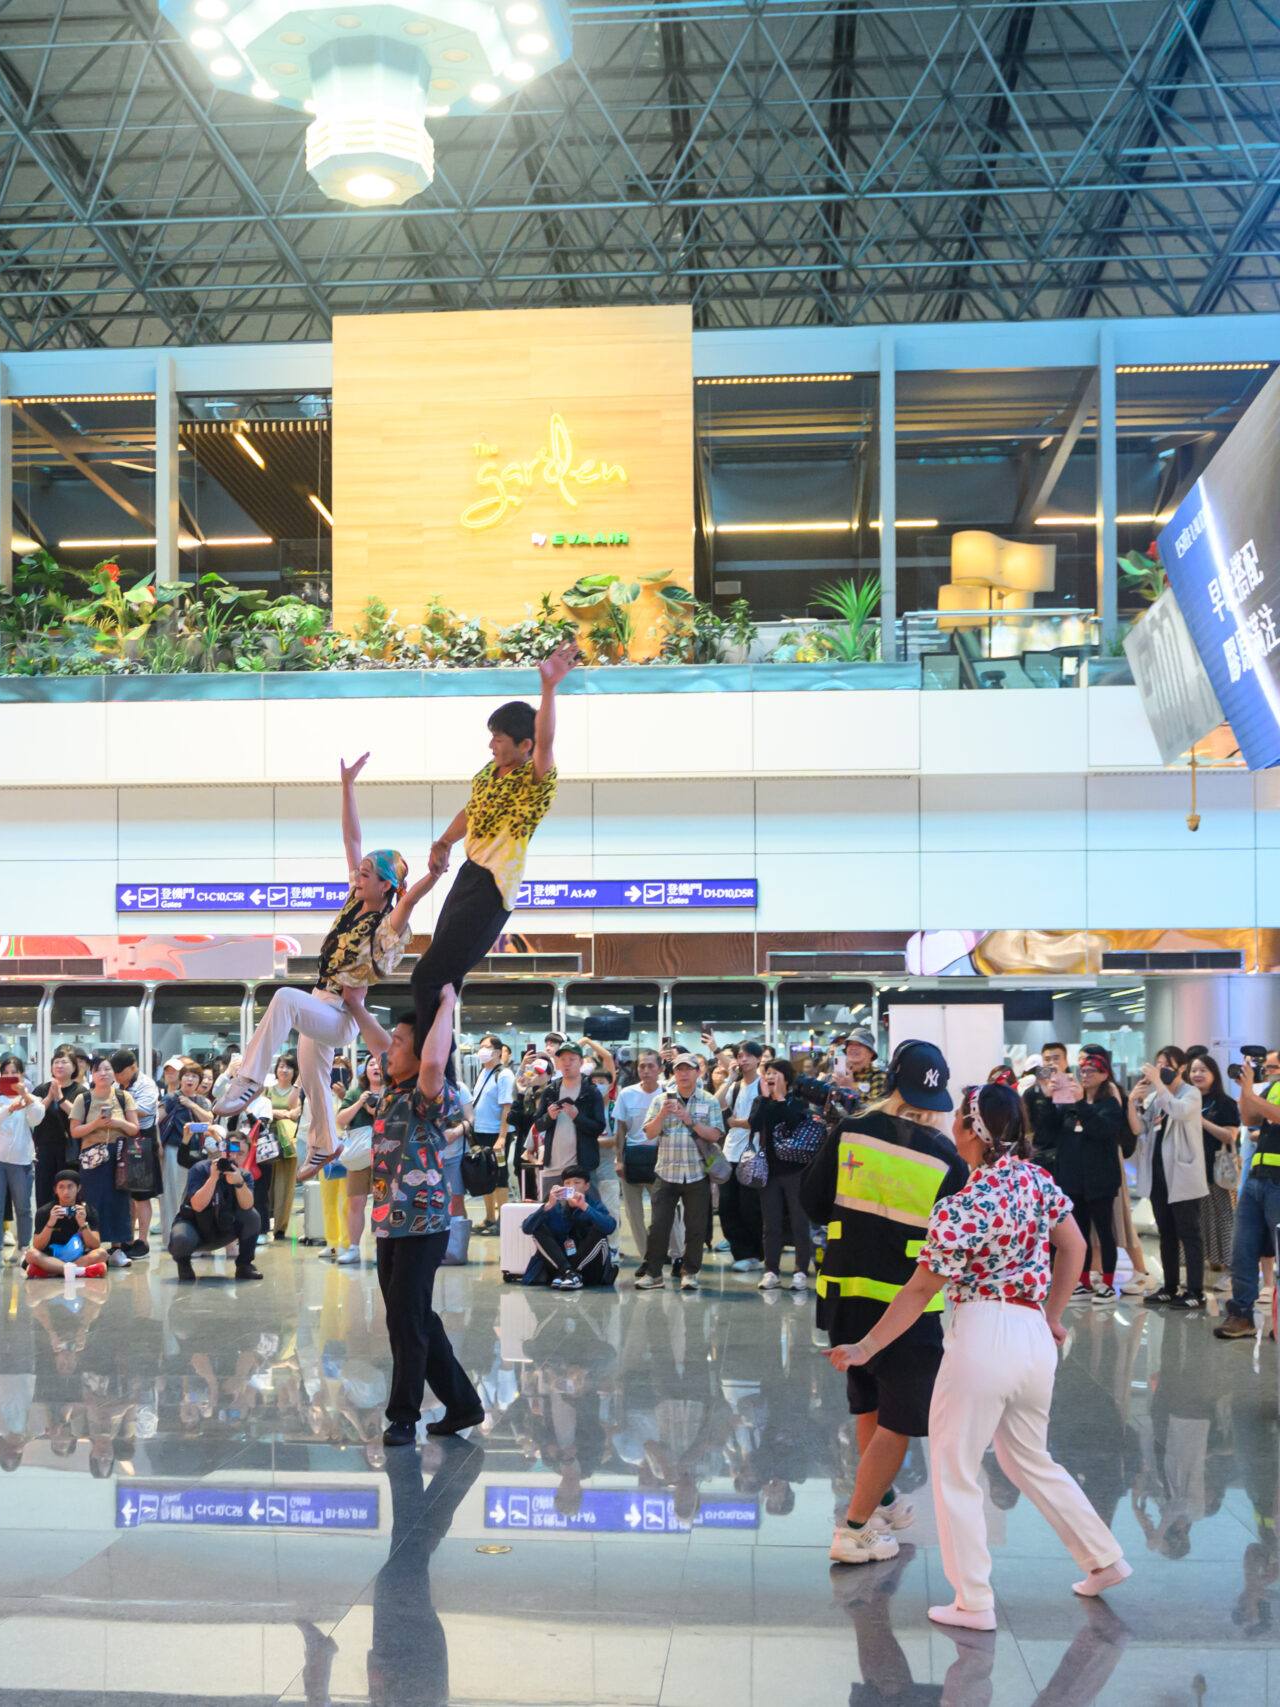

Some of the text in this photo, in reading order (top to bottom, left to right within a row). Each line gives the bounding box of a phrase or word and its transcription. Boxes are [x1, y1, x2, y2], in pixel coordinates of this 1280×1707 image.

[472, 442, 499, 457] The
[460, 413, 628, 528] garden
[551, 532, 591, 545] EVA
[592, 531, 629, 544] AIR
[923, 1068, 940, 1087] NY
